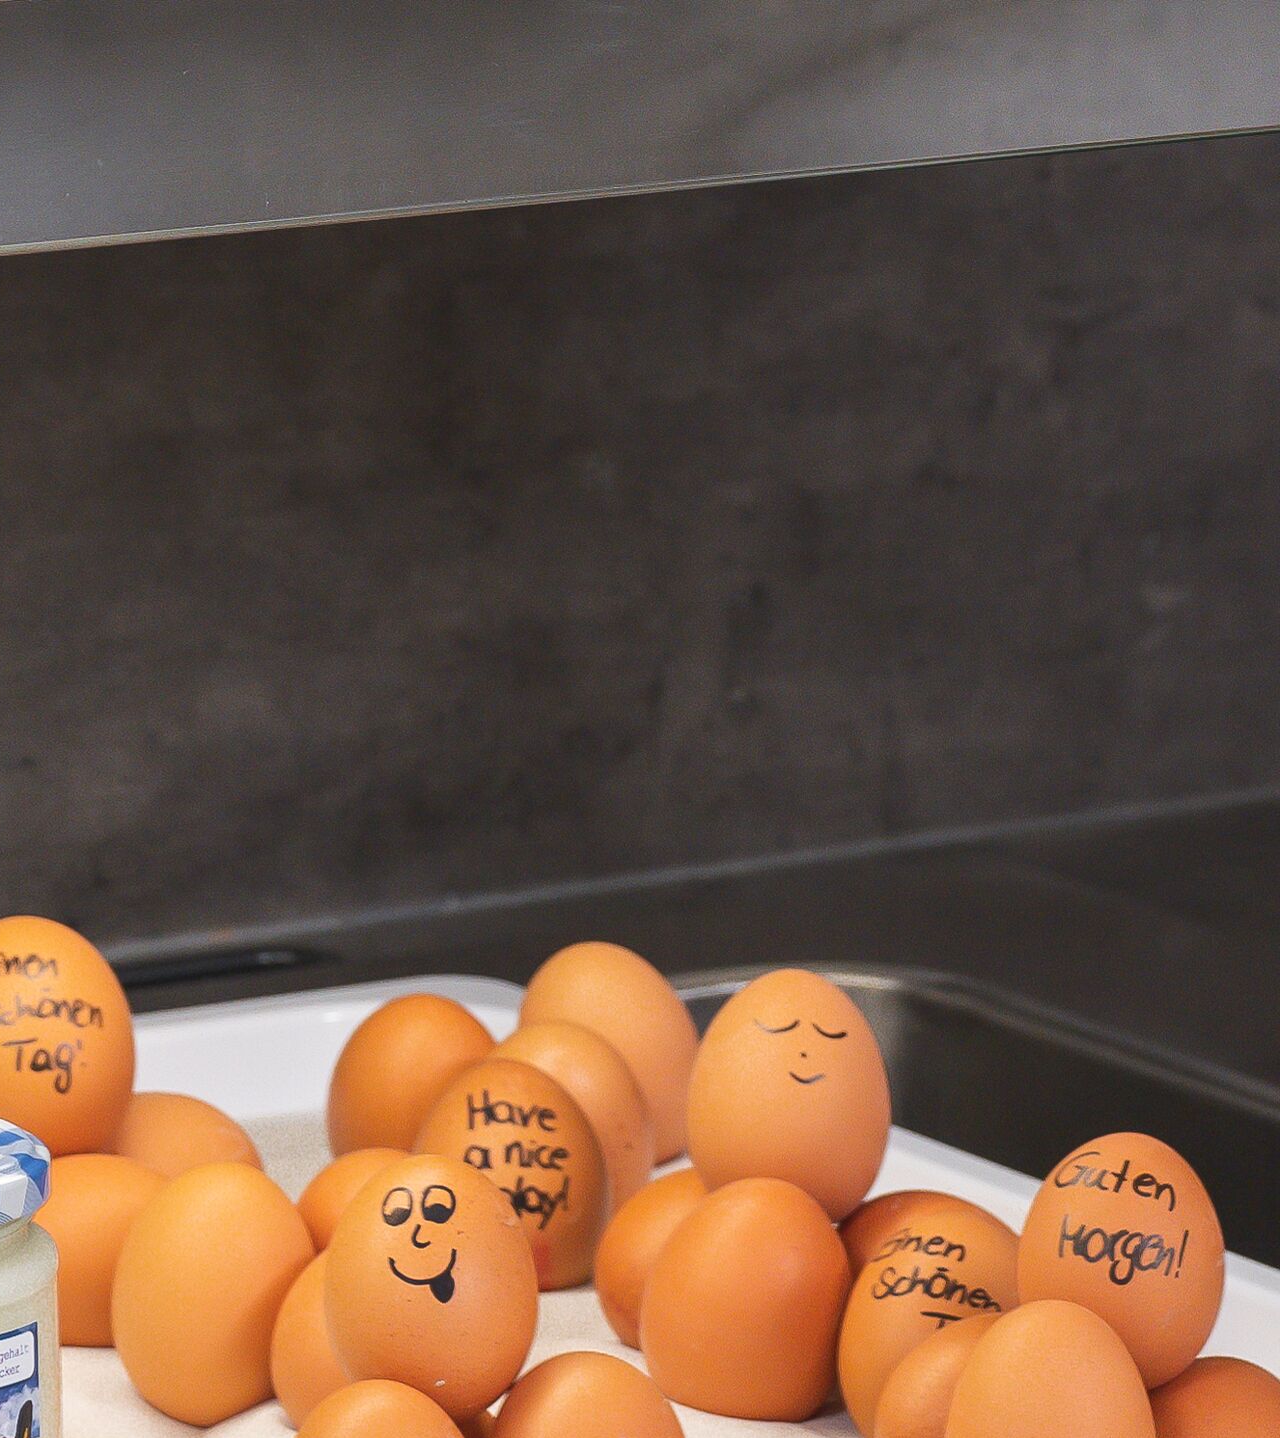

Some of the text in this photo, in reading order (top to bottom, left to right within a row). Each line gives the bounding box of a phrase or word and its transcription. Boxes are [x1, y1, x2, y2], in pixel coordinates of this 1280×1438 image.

[466, 1089, 556, 1131] Have
[463, 1140, 569, 1170] a nice
[1054, 1151, 1176, 1212] Guten
